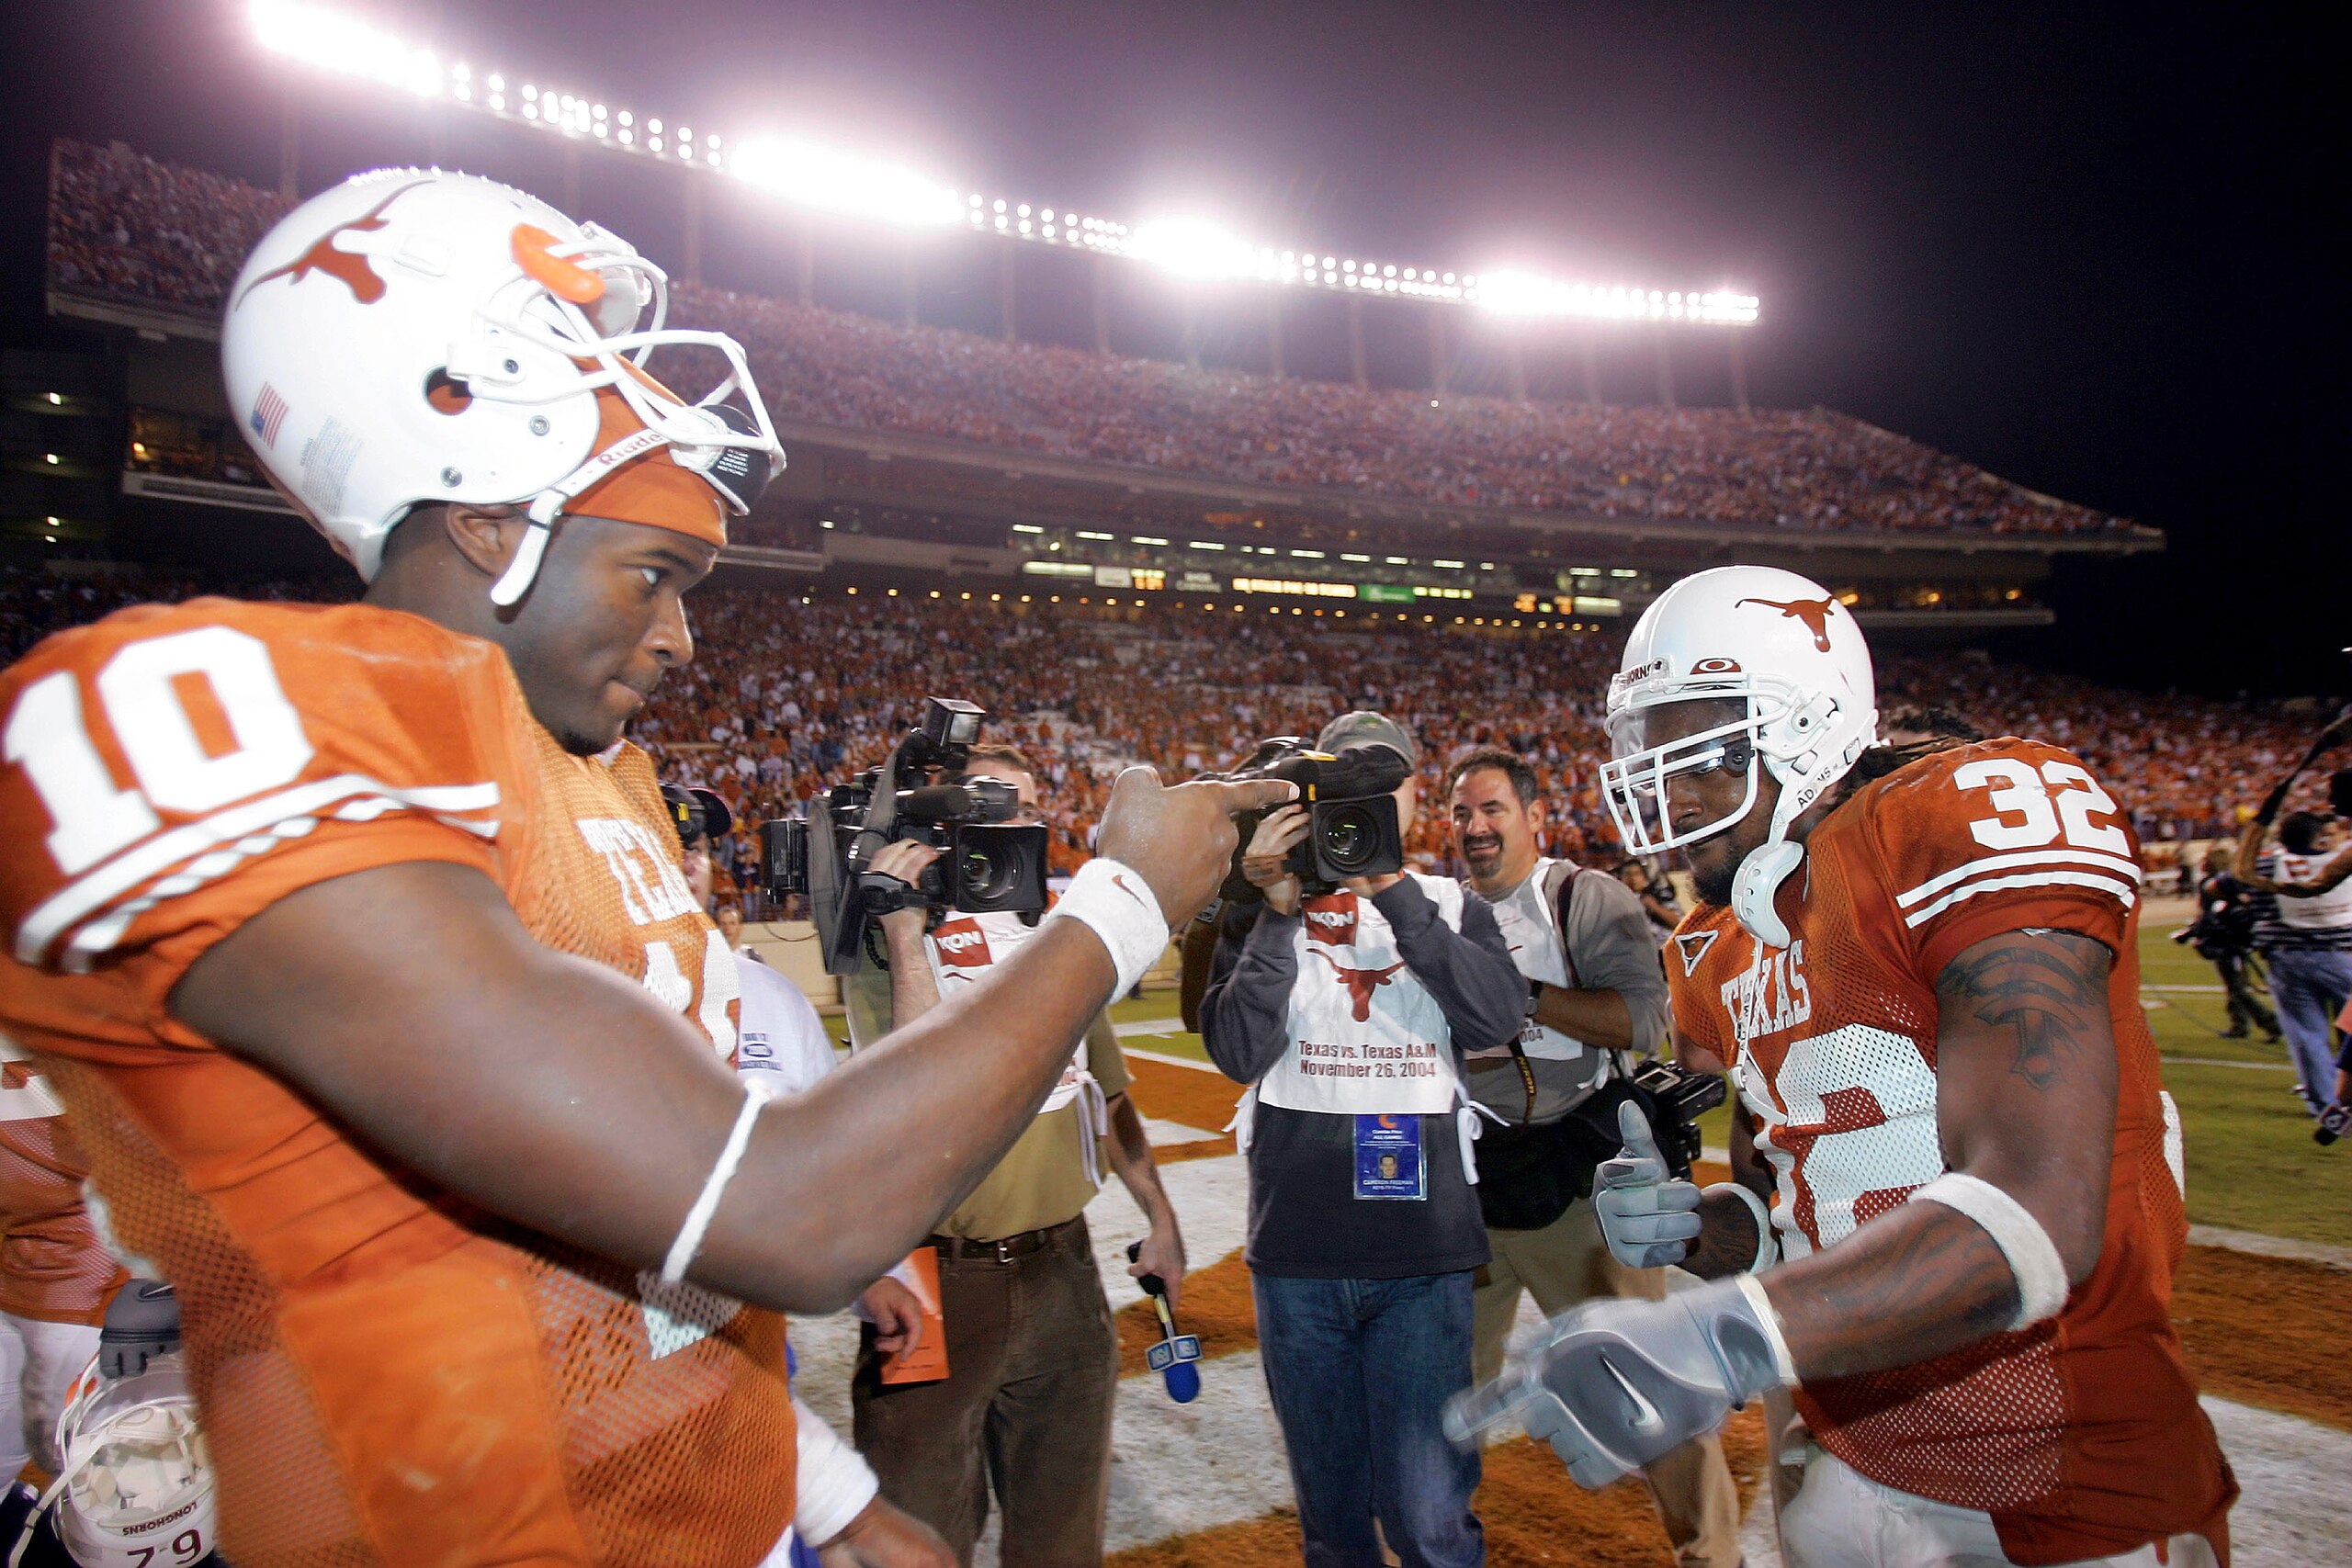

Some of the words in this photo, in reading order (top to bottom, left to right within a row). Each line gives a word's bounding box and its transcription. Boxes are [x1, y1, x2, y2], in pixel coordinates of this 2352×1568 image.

[4, 625, 315, 876] 10
[1953, 758, 2132, 858] 32
[1298, 1040, 1339, 1057] Texas
[1340, 1043, 1358, 1058] vs.
[1361, 1043, 1402, 1059] Texas
[1406, 1043, 1436, 1058] A&M
[1300, 1059, 1371, 1077] November
[1399, 1062, 1436, 1077] 2004
[122, 1500, 198, 1536] LONGHORNS
